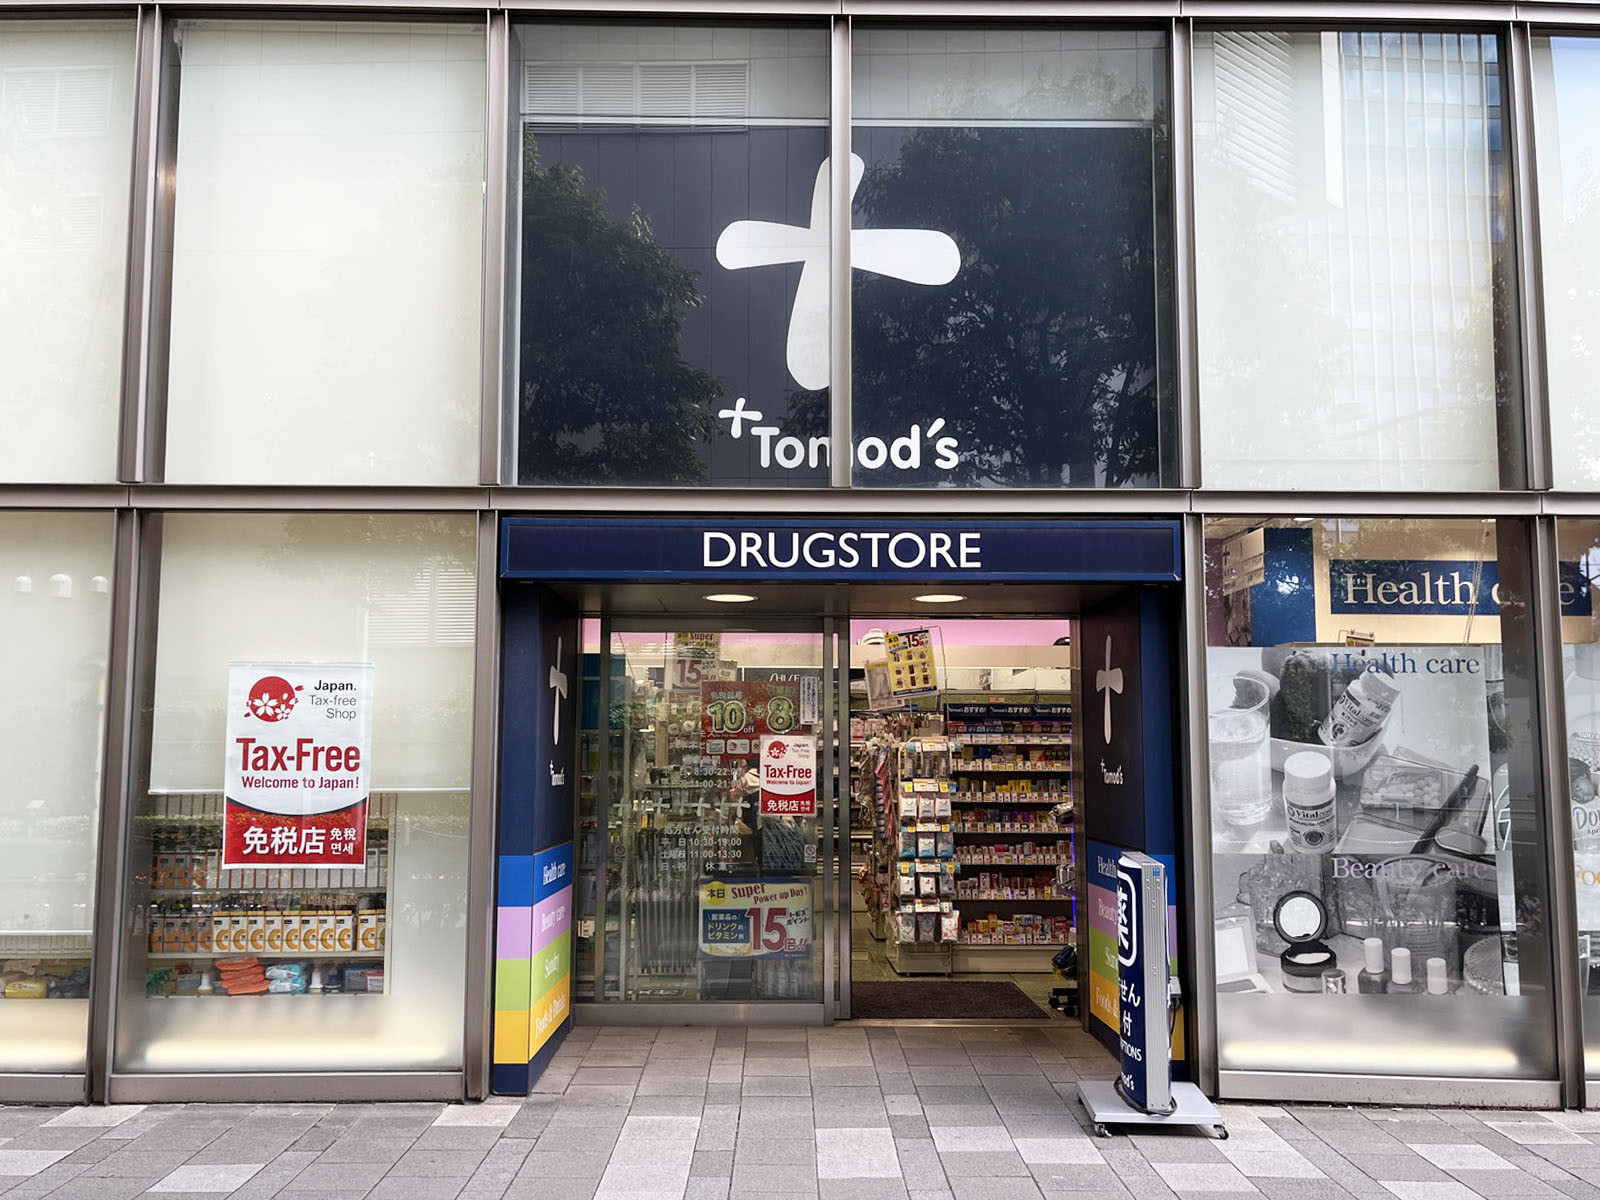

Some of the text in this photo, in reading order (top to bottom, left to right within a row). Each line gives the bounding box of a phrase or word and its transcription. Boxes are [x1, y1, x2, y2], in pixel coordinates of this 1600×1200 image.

[703, 532, 982, 569] DRUGSTORE
[1344, 571, 1479, 606] Health
[906, 633, 920, 648] 15
[677, 660, 702, 684] 15
[1331, 653, 1480, 674] Health care
[314, 680, 357, 693] Japan.
[310, 695, 357, 706] Tax-free
[326, 708, 357, 721] Shop
[236, 737, 360, 772] Tax-Free
[764, 764, 812, 779] Tax-Free
[242, 776, 359, 791] Welcome to Japan!
[767, 800, 799, 812] 免税店
[242, 826, 327, 855] 免税店
[331, 842, 354, 856] 면세
[689, 838, 742, 846] 10:30-19:00
[690, 850, 742, 858] 11:00-13:30
[1097, 856, 1118, 879] Health
[1332, 857, 1488, 881] Beauty care
[707, 889, 726, 899] 本日
[731, 883, 766, 900] Super
[754, 886, 808, 905] Power up Day!
[1098, 898, 1119, 926] Beauty
[746, 907, 788, 951] 15
